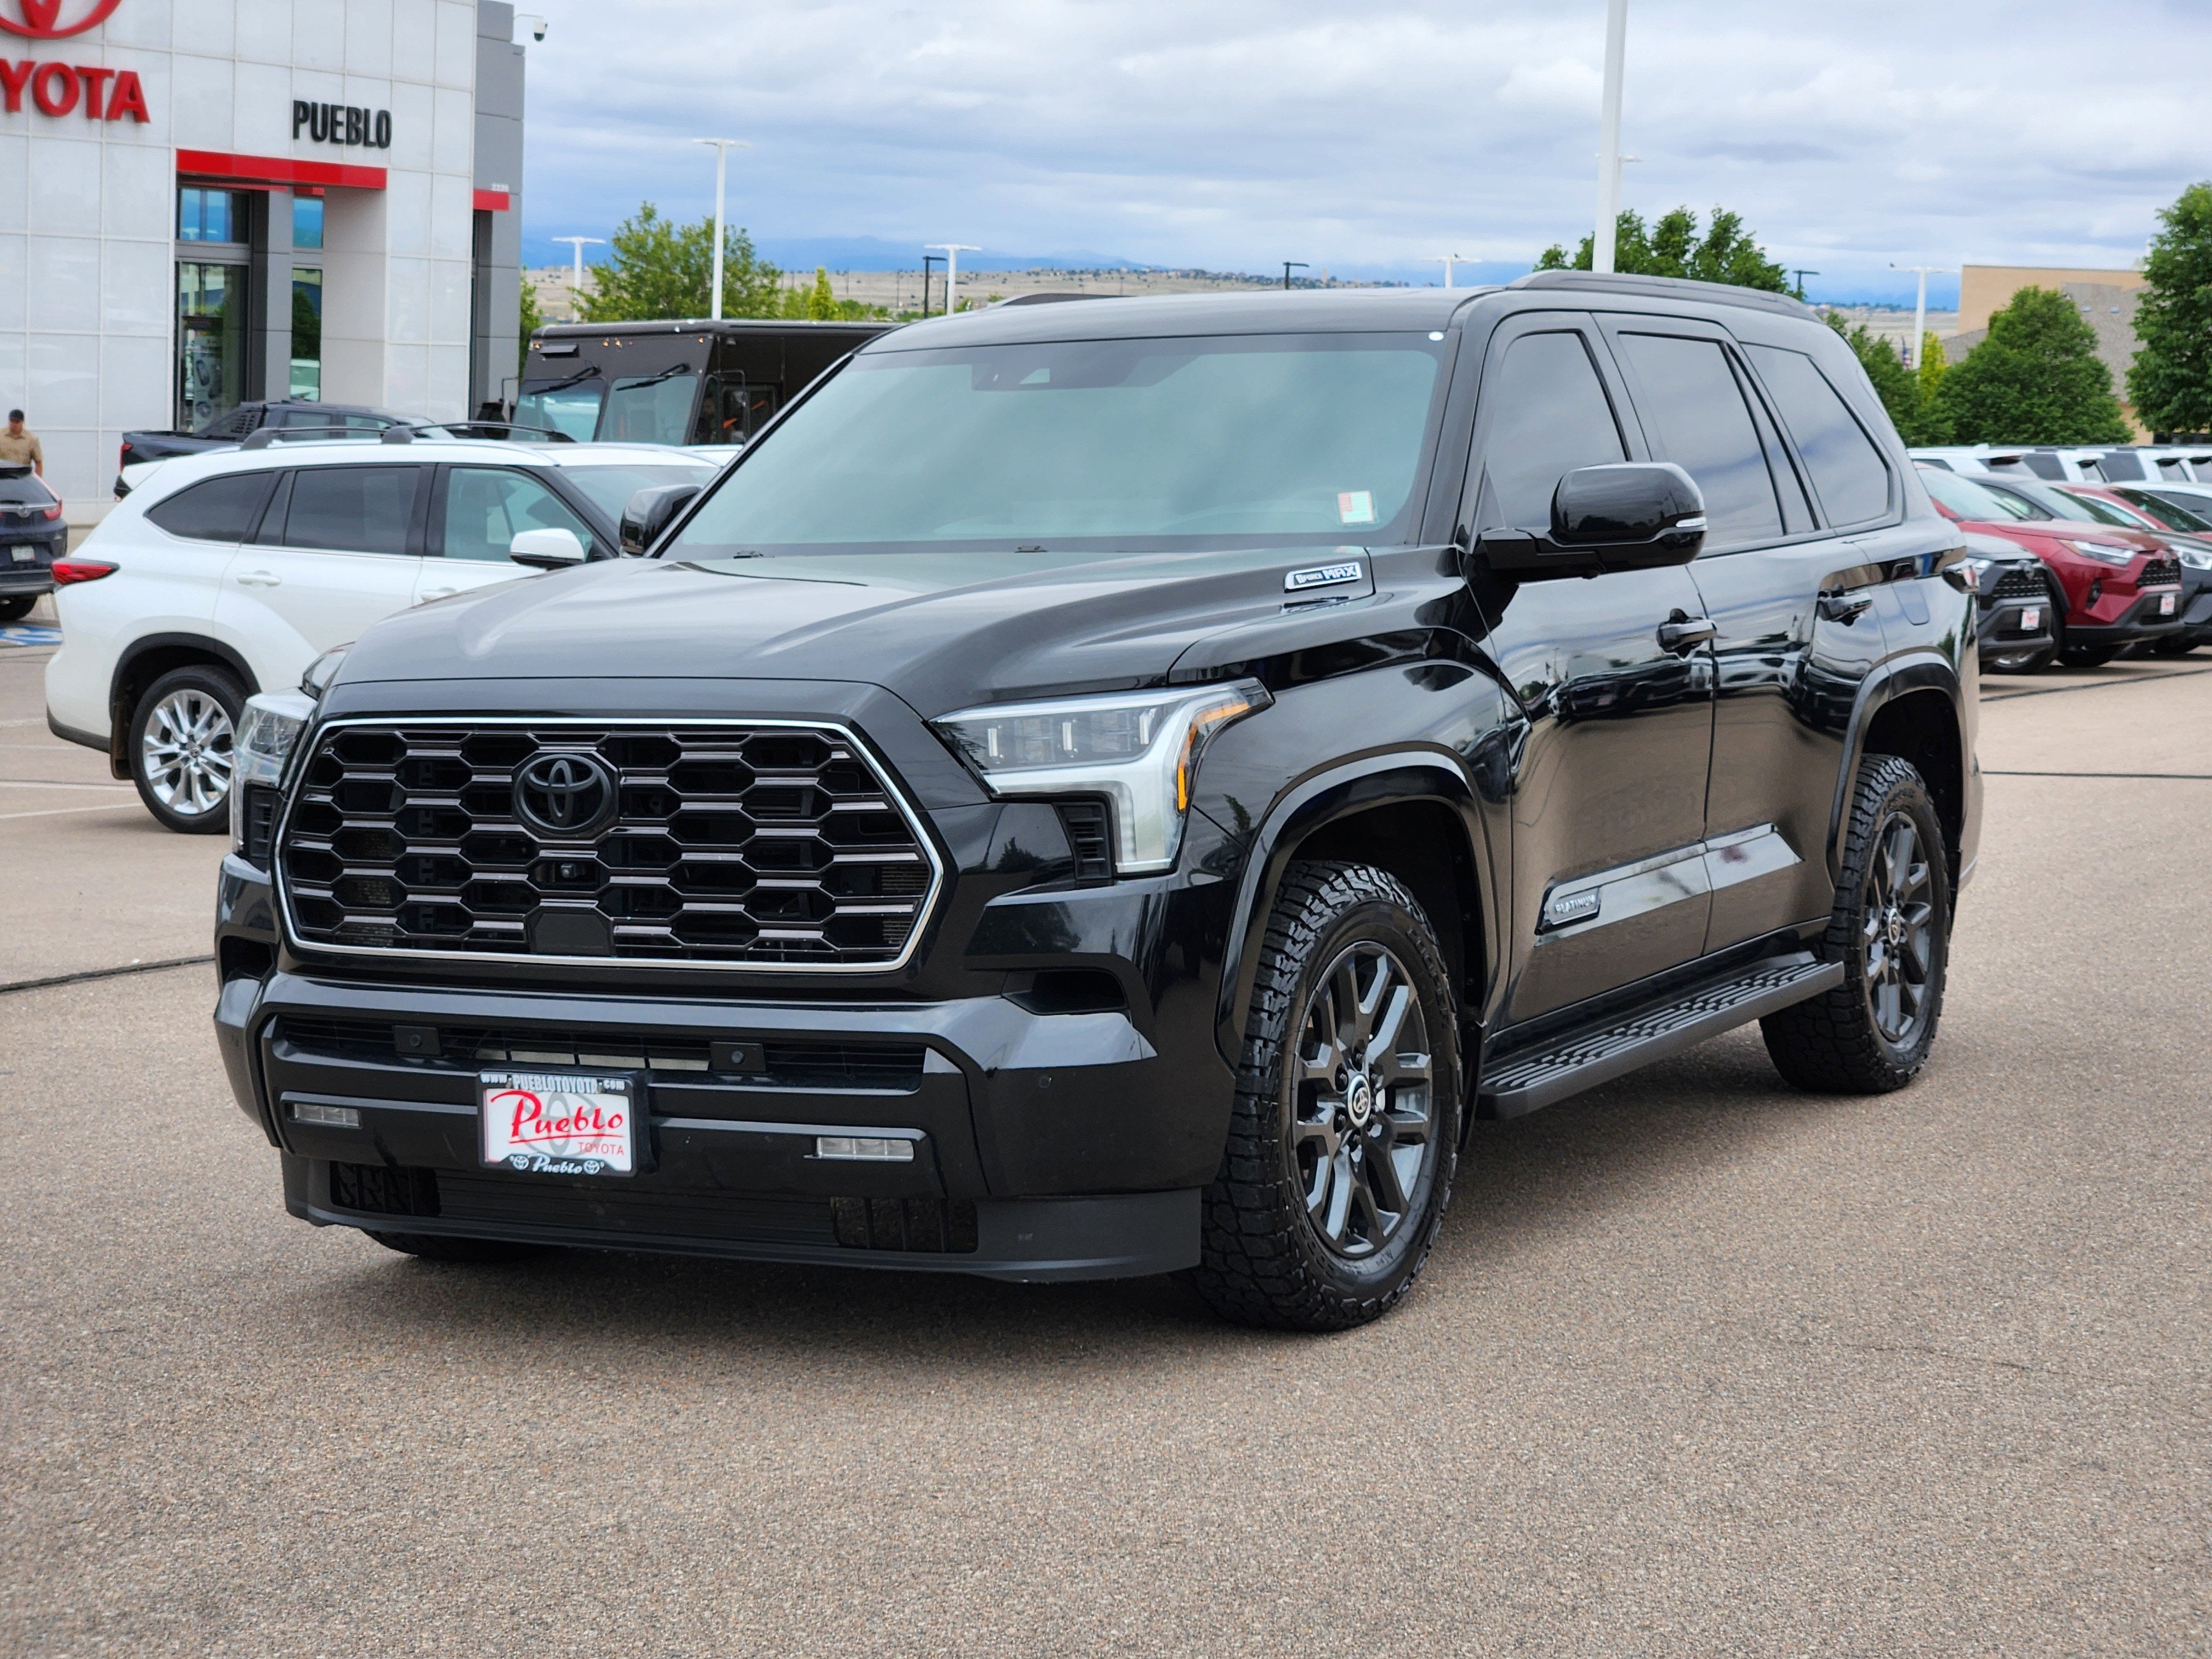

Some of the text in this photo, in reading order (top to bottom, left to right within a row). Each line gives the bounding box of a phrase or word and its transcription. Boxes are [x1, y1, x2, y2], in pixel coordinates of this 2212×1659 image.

[293, 100, 392, 149] PUEBLO
[1323, 566, 1357, 580] MAX
[1554, 894, 1597, 913] PLATINUM
[491, 1089, 623, 1138] Pueblo
[577, 1141, 624, 1155] TOYOTA
[527, 1152, 583, 1175] Pueblo
